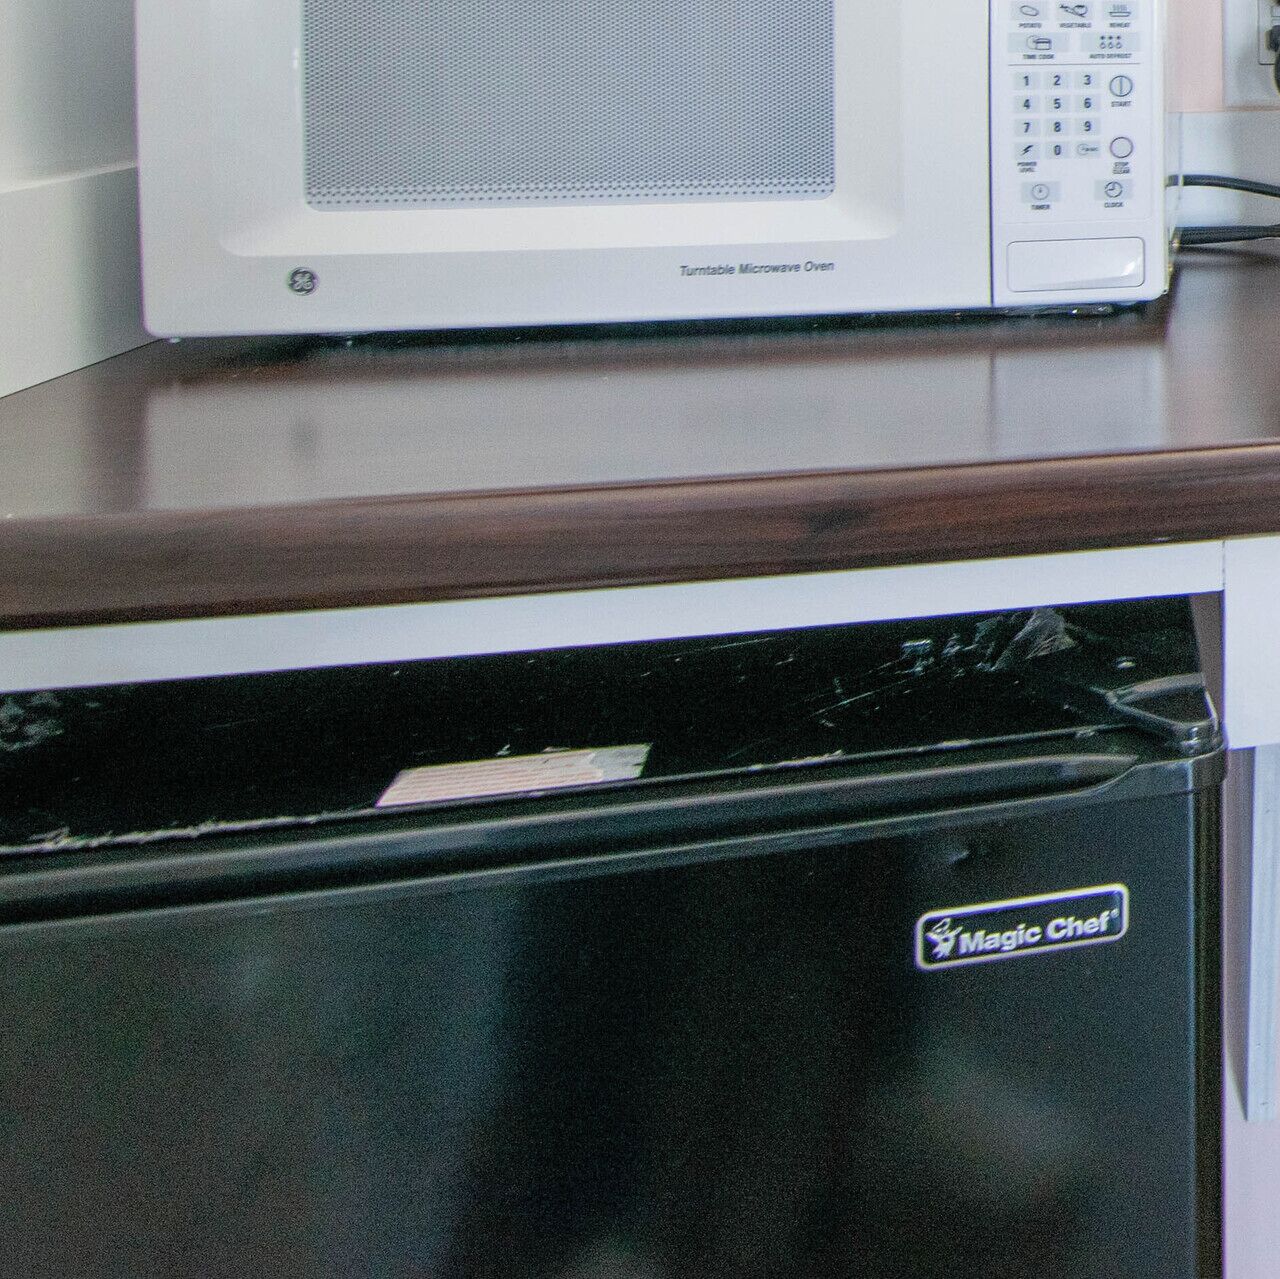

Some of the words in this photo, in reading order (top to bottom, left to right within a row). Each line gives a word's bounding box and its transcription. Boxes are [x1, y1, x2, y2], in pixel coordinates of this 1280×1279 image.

[1023, 75, 1029, 86] 1
[1053, 74, 1061, 86] 2
[1083, 74, 1091, 86] 3
[1023, 99, 1031, 109] 4
[1053, 98, 1061, 109] 5
[1083, 97, 1091, 109] 6
[1023, 122, 1031, 133] 7
[1053, 121, 1061, 133] 8
[1083, 121, 1091, 132] 9
[1053, 144, 1061, 156] 0
[679, 265, 735, 277] Turntable
[738, 262, 801, 275] Microwave
[803, 260, 835, 272] Oven
[957, 923, 1042, 955] Magic
